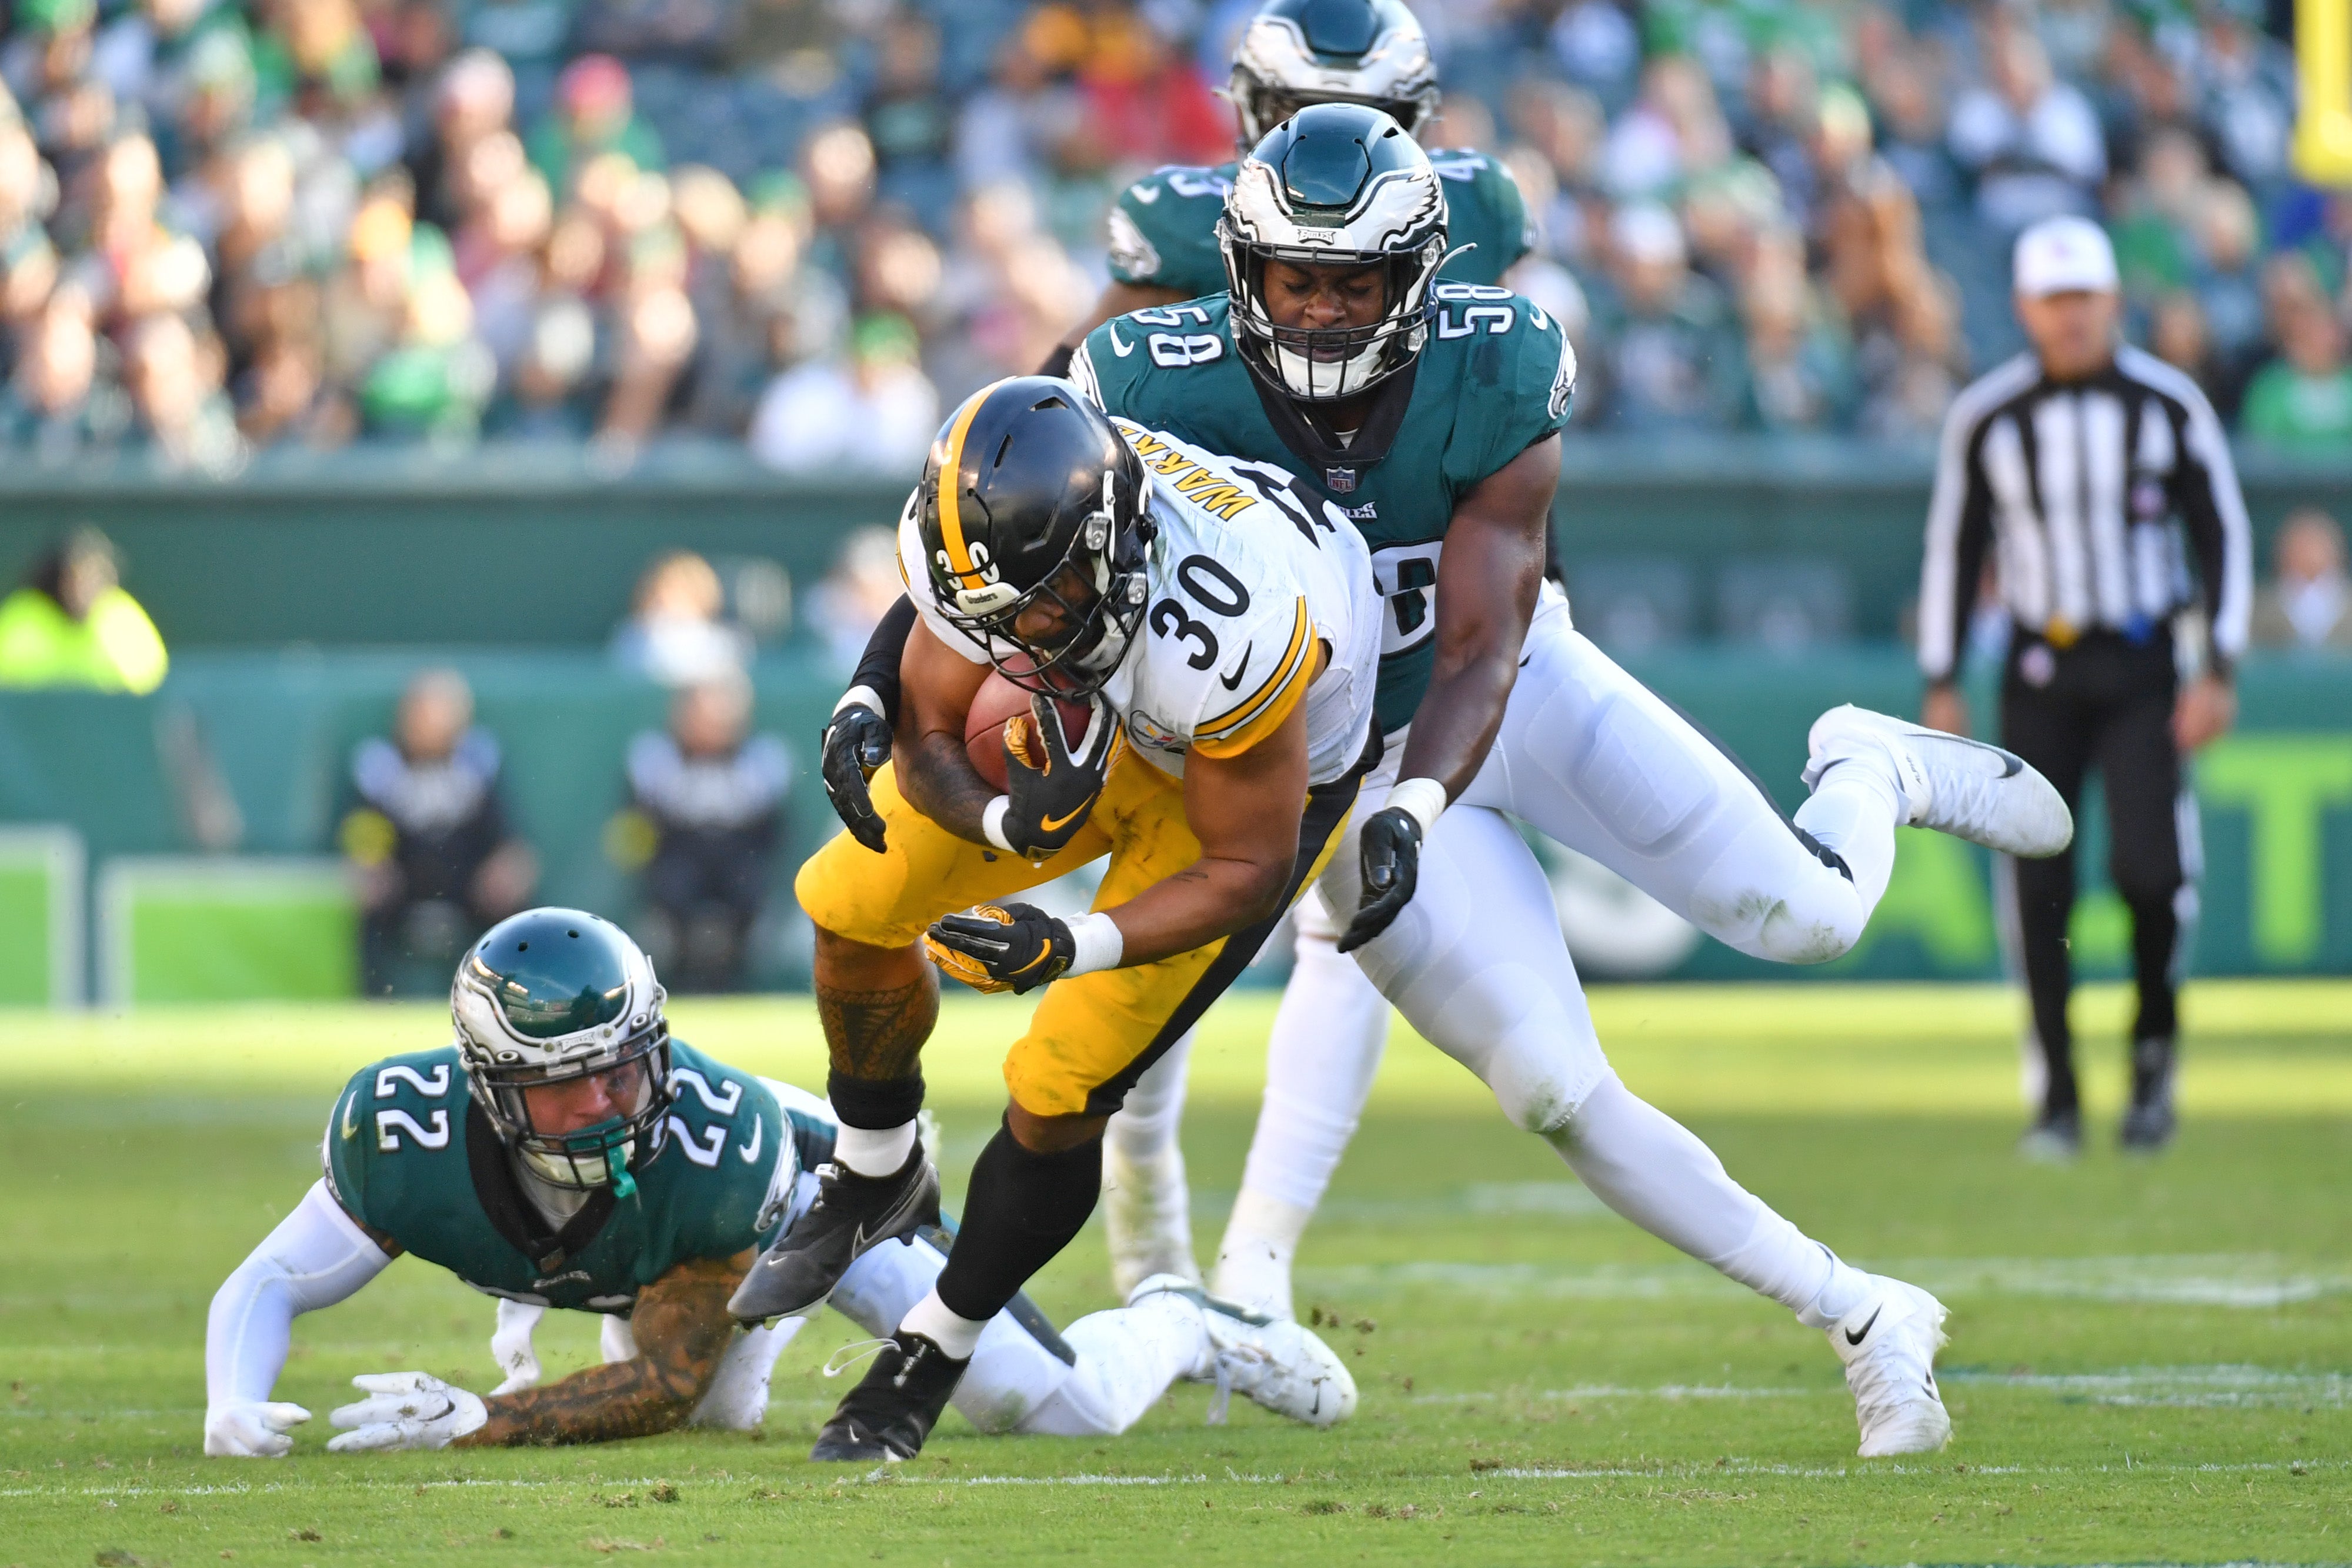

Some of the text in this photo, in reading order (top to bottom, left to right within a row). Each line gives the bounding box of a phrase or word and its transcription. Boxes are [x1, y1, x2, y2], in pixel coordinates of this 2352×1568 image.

[1127, 306, 1225, 369] 58
[1436, 283, 1516, 341] 58
[1331, 479, 1352, 490] NFL
[936, 541, 1000, 590] 30
[1150, 554, 1250, 670] 30
[373, 1063, 451, 1153] 22
[650, 1066, 745, 1169] 22
